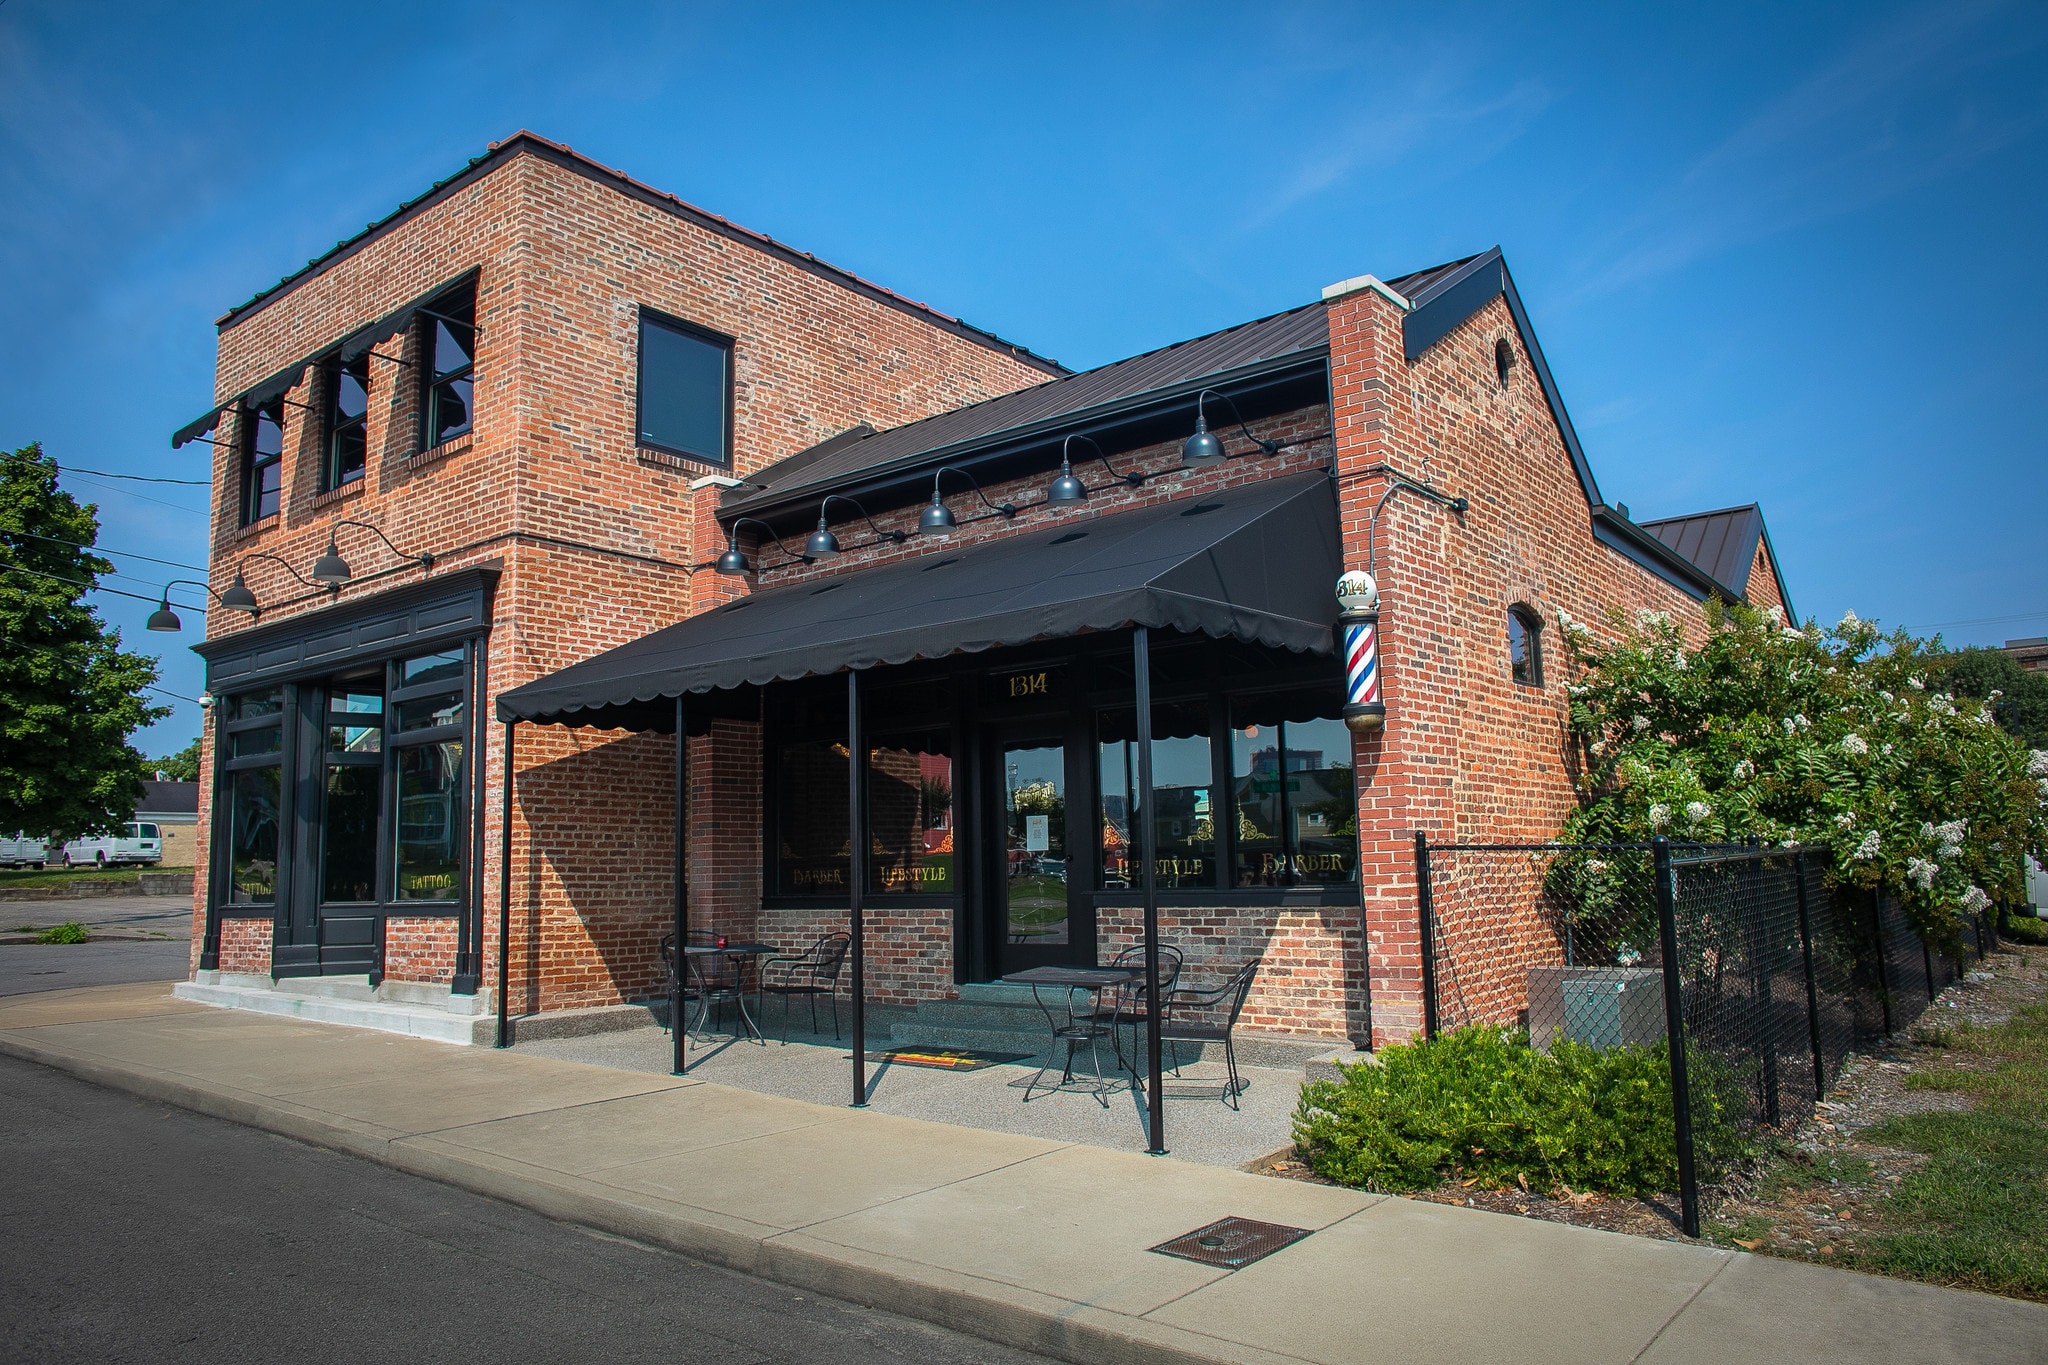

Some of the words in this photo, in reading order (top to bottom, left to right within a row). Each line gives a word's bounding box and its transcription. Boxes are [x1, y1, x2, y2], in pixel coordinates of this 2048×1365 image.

[1010, 673, 1048, 697] 1314
[1116, 858, 1204, 881] LIFSTYLE
[1262, 852, 1347, 876] BARBER
[410, 874, 452, 890] TATTOO
[793, 868, 845, 885] BARBER
[880, 866, 946, 887] LIFESTYLE
[241, 882, 272, 896] TATTOO
